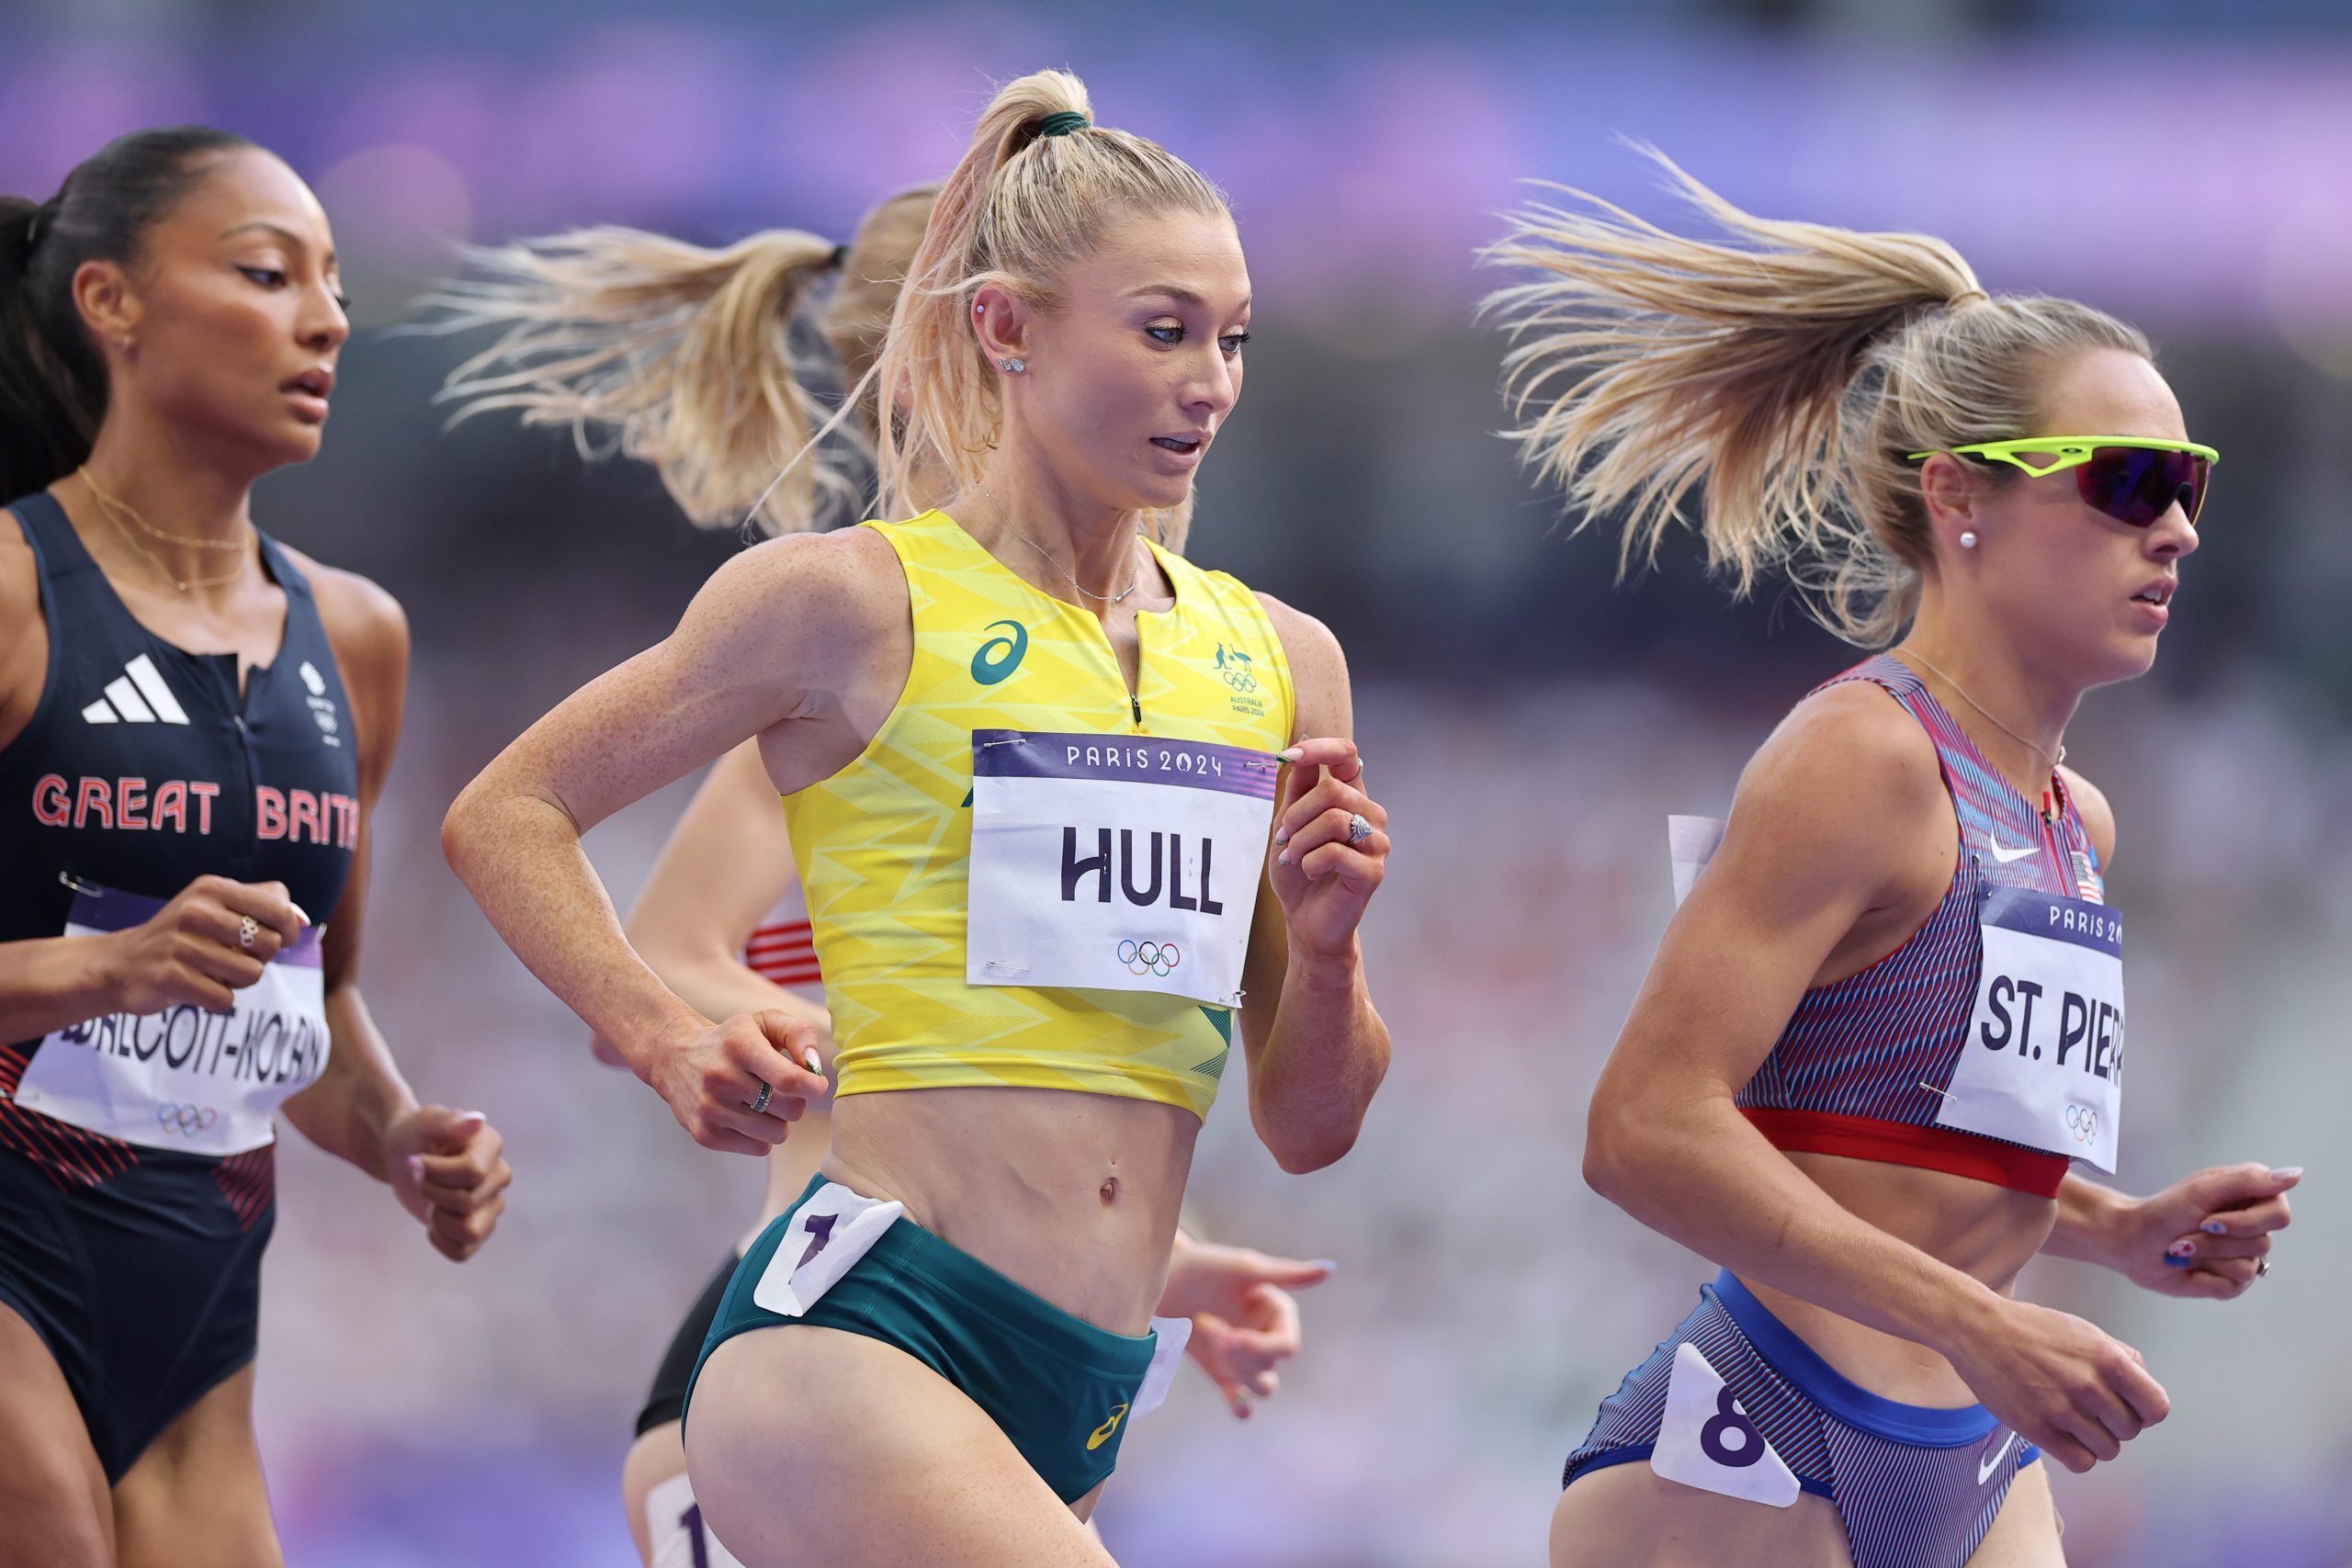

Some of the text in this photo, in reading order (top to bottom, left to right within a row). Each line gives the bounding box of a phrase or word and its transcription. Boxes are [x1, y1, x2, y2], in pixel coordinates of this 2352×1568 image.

[1230, 696, 1262, 706] AUSTRALIA
[1159, 750, 1223, 777] 2024
[32, 773, 221, 835] GREAT
[1061, 827, 1224, 916] HULL
[1981, 975, 2043, 1061] ST.
[1701, 1384, 1766, 1467] 8
